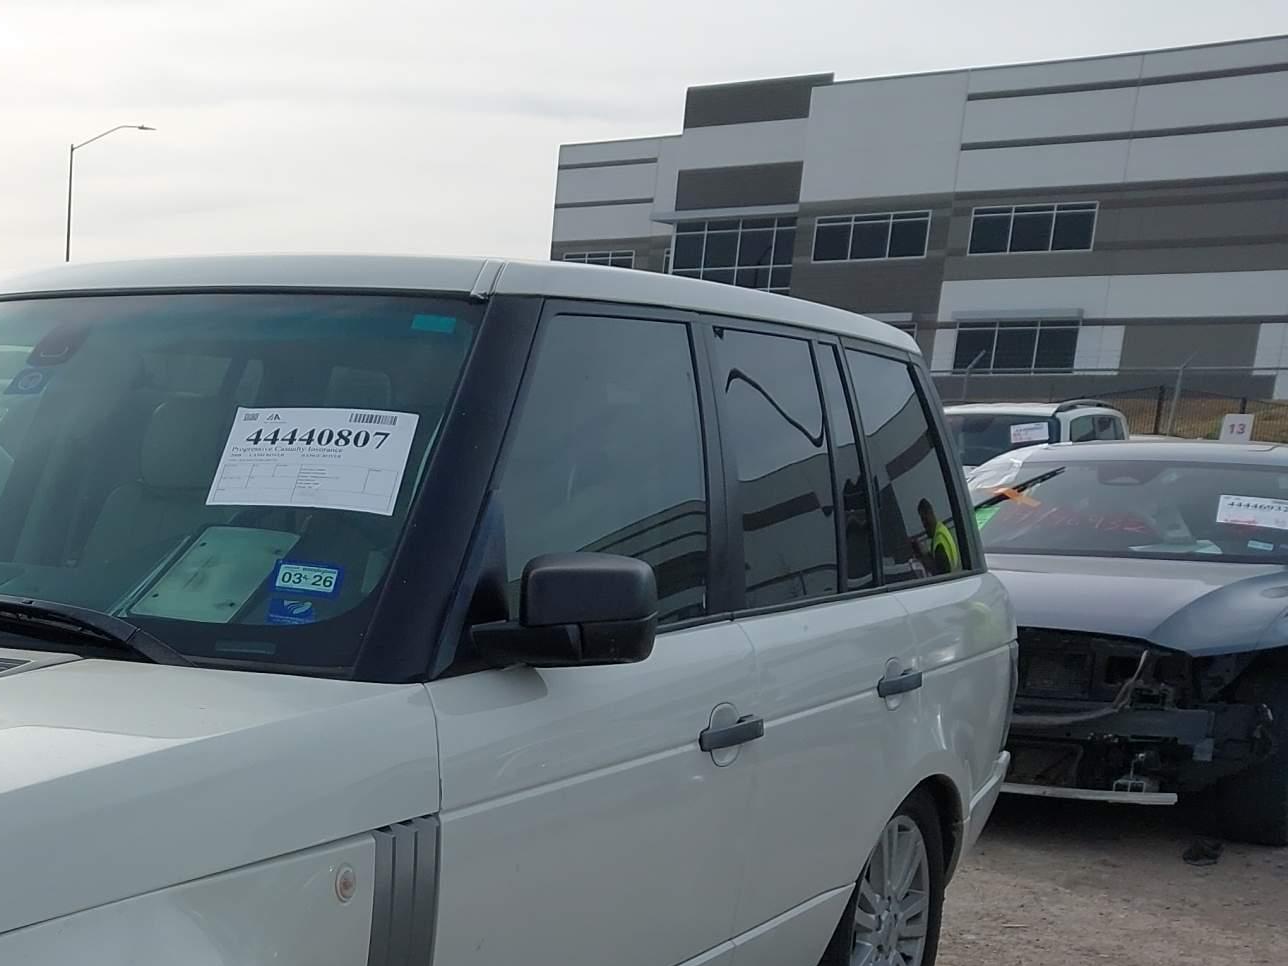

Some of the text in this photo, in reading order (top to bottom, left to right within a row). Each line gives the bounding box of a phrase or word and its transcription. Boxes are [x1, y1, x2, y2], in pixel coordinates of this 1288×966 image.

[1229, 423, 1246, 435] 13
[245, 427, 391, 449] 44440807
[281, 571, 334, 588] 03 26
